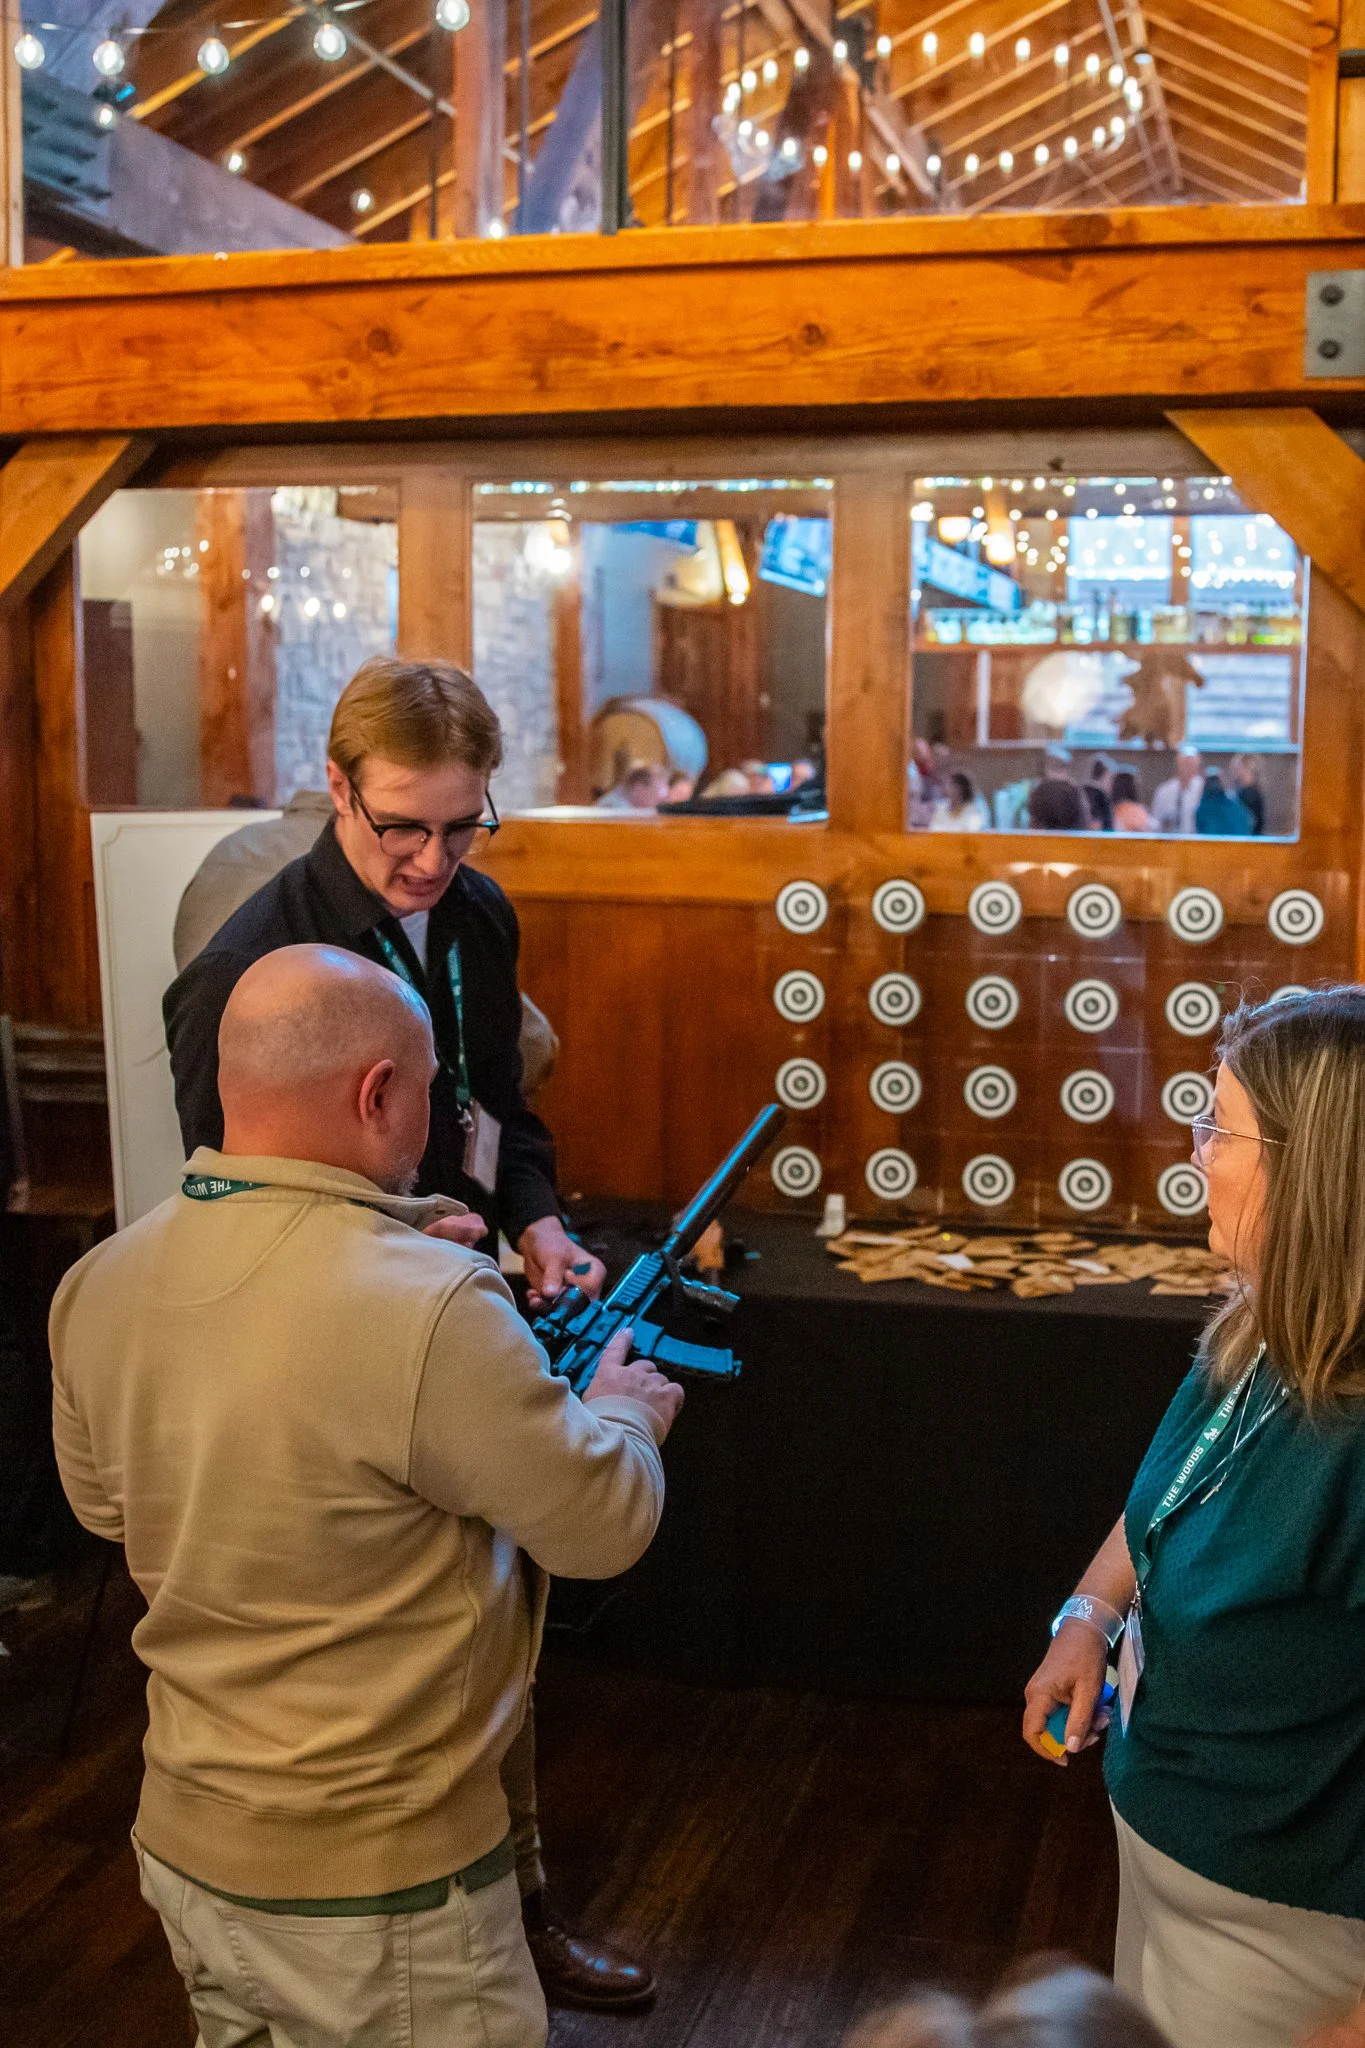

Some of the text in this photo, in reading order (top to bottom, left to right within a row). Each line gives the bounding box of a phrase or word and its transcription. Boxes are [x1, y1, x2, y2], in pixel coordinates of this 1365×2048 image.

[210, 1180, 232, 1193] THE
[1218, 1397, 1235, 1418] THE
[1162, 1445, 1204, 1507] THE WOODS
